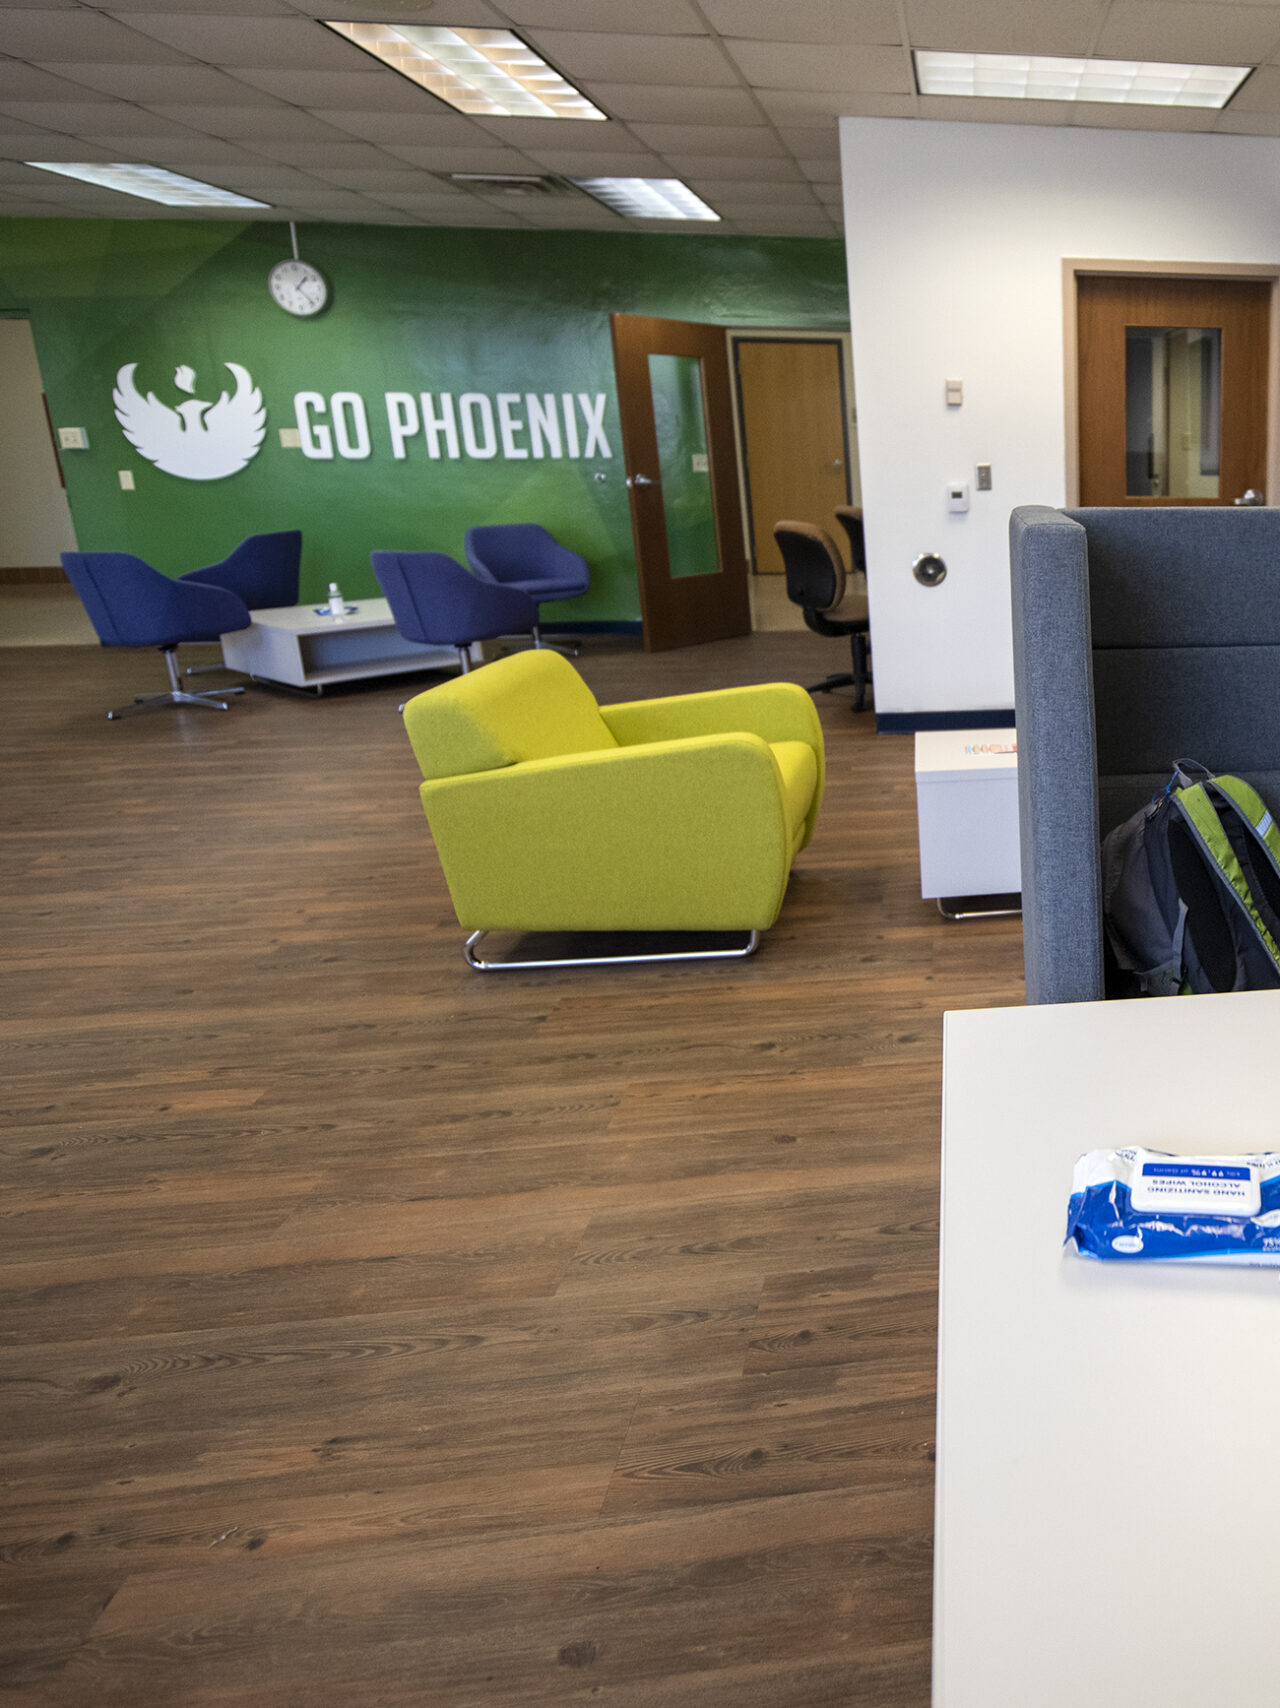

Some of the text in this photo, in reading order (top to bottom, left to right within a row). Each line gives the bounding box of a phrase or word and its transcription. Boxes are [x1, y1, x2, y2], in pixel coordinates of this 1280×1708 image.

[294, 392, 613, 459] GO PHOENIX
[1191, 1180, 1240, 1188] ALCOHOL
[1147, 1186, 1210, 1194] SANITIZING
